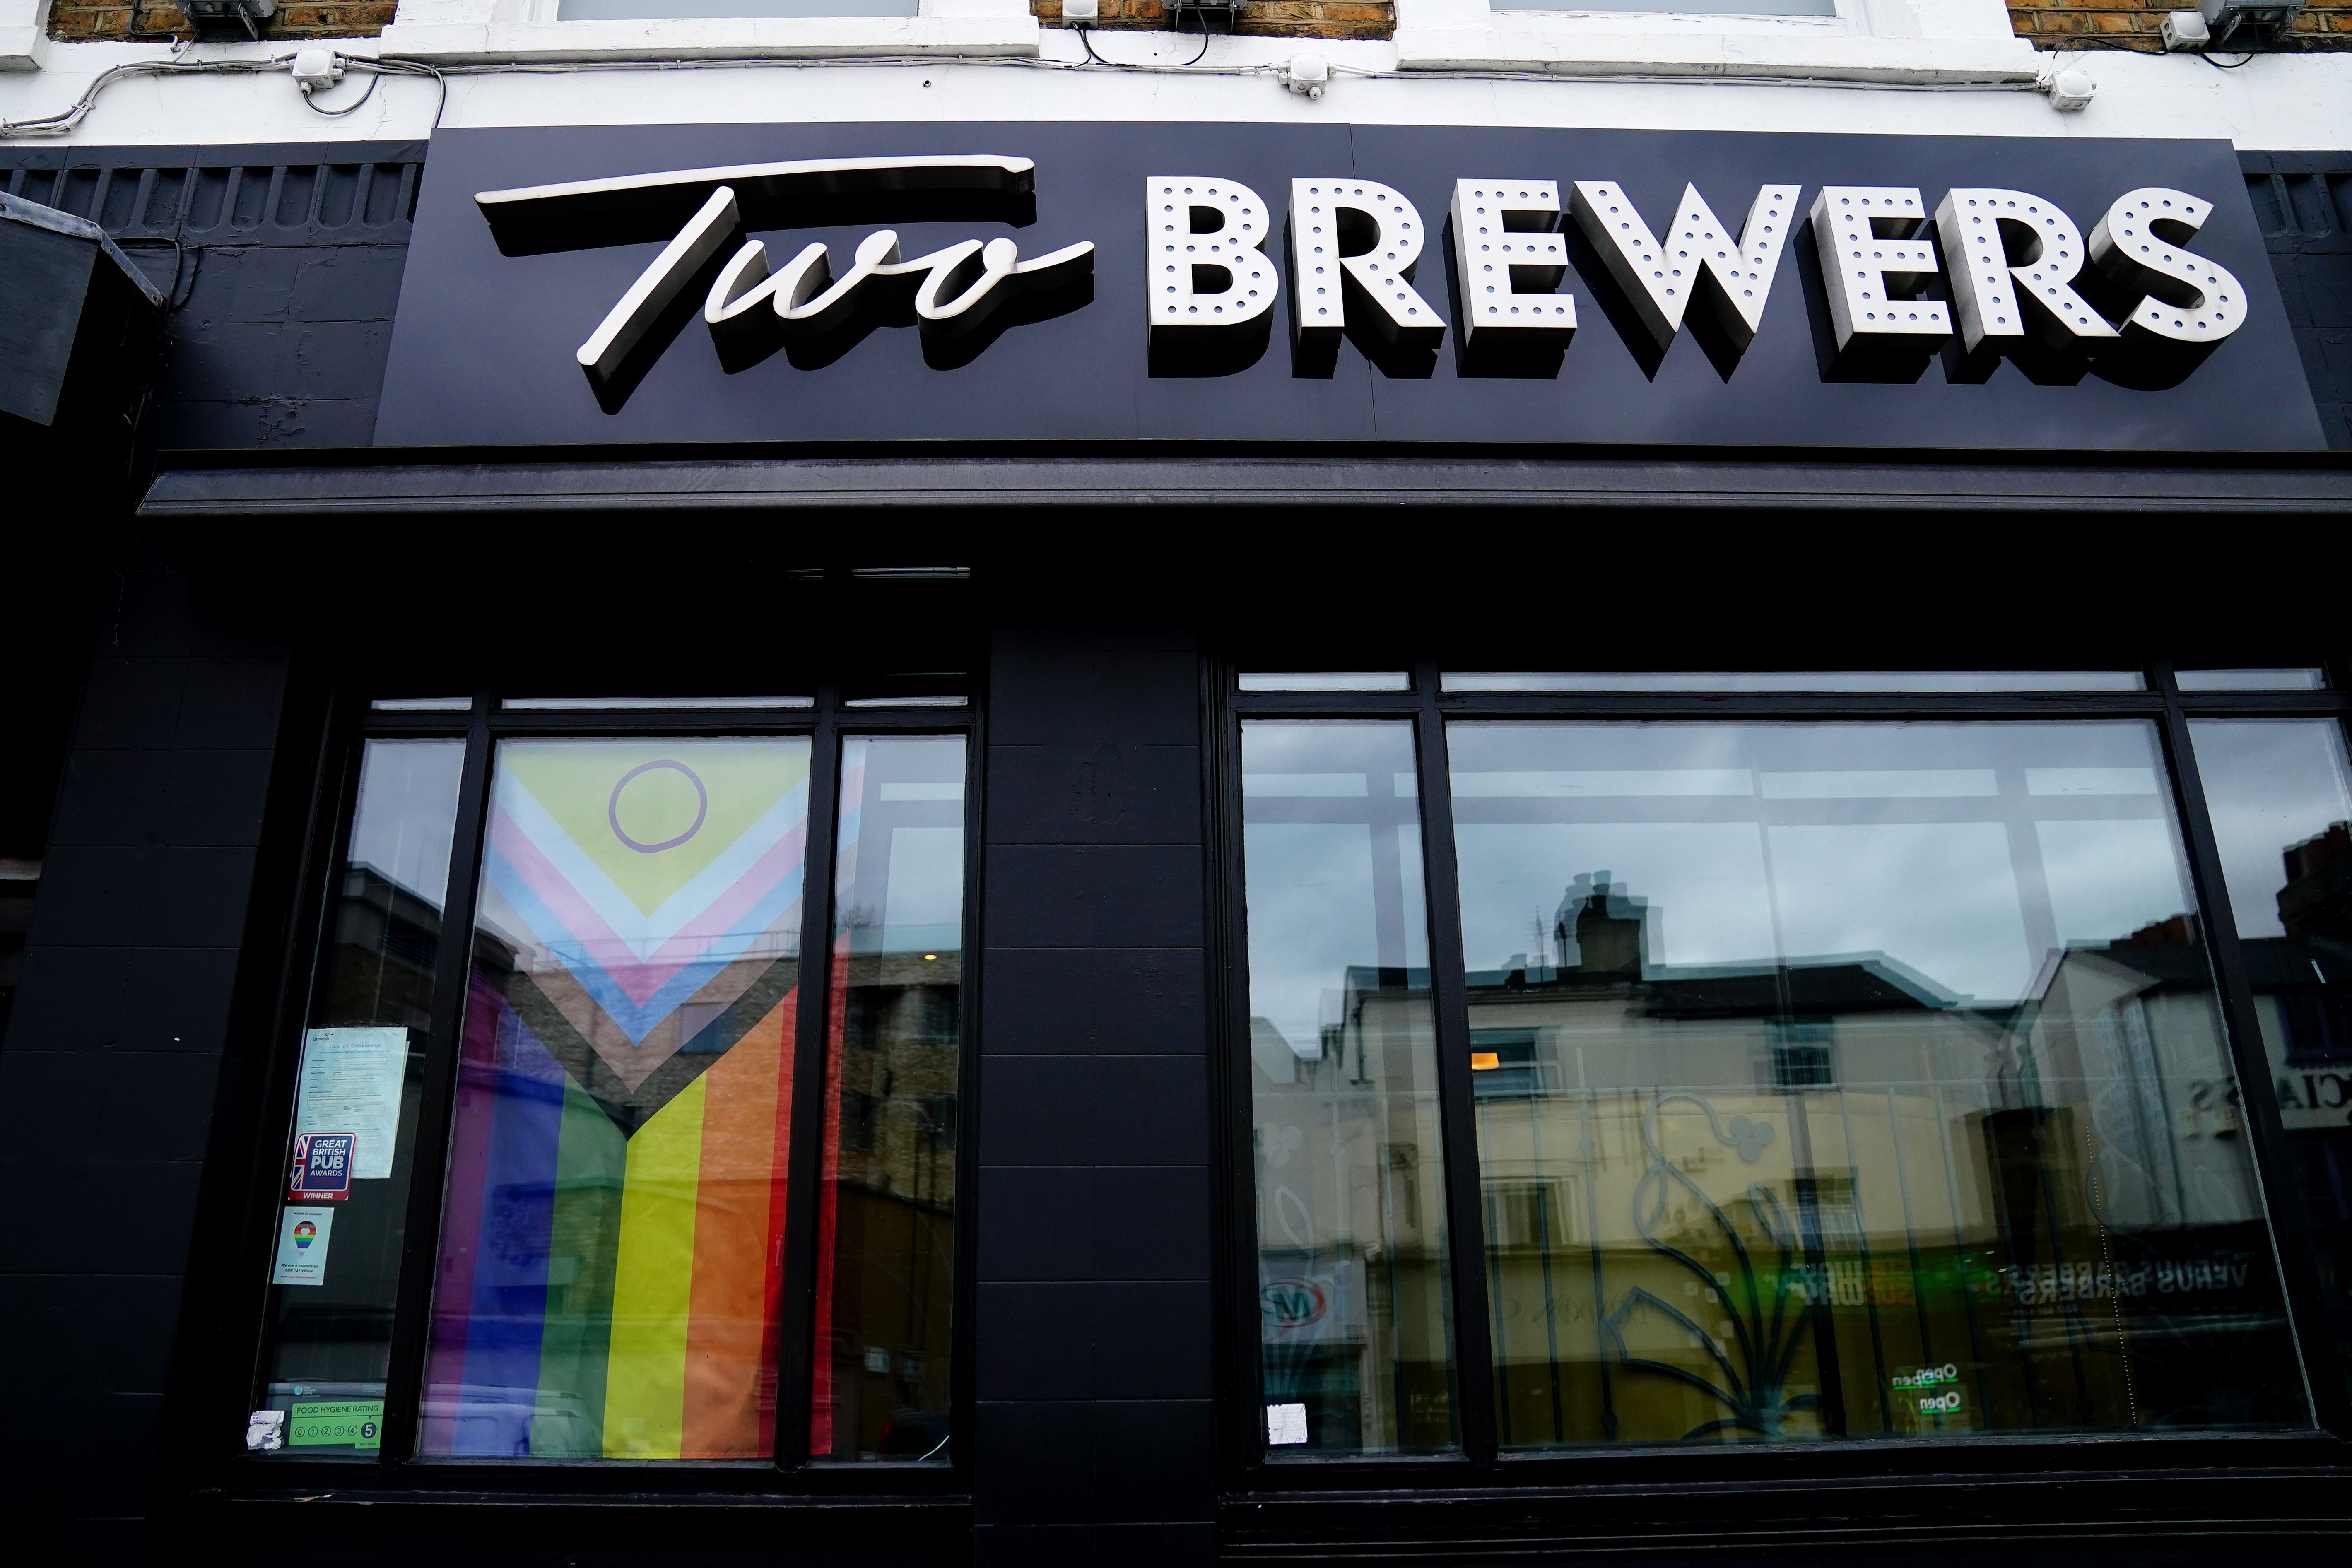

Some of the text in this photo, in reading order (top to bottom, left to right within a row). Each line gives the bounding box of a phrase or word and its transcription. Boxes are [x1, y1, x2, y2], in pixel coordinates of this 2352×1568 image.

[475, 154, 2248, 366] Two BREWERS
[314, 1139, 348, 1148] GREAT
[311, 1156, 344, 1169] PUB
[364, 1424, 373, 1437] 5
